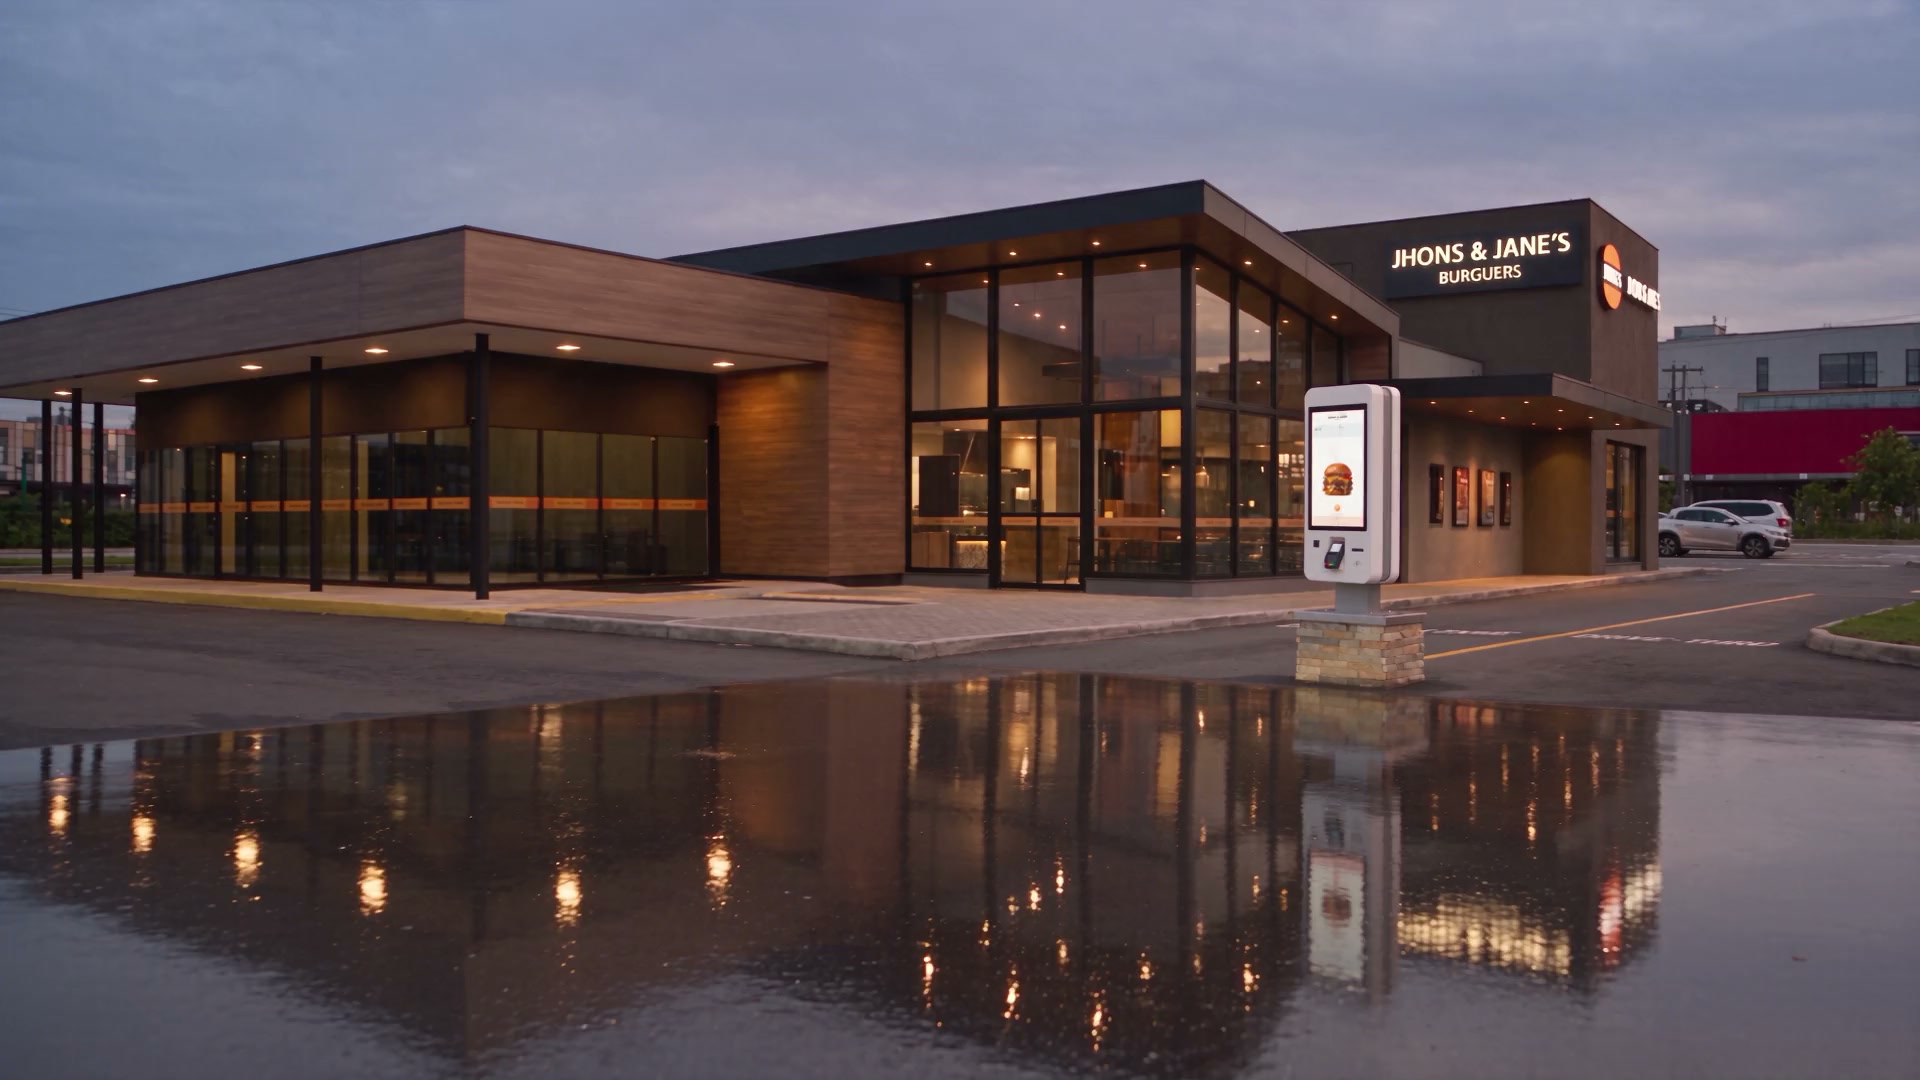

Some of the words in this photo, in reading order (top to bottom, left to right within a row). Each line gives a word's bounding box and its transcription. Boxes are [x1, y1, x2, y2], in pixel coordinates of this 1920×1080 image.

[1391, 243, 1465, 269] JHONS
[1470, 241, 1488, 261] &
[1492, 232, 1571, 260] JANE'S
[1438, 264, 1522, 285] BURGUERS
